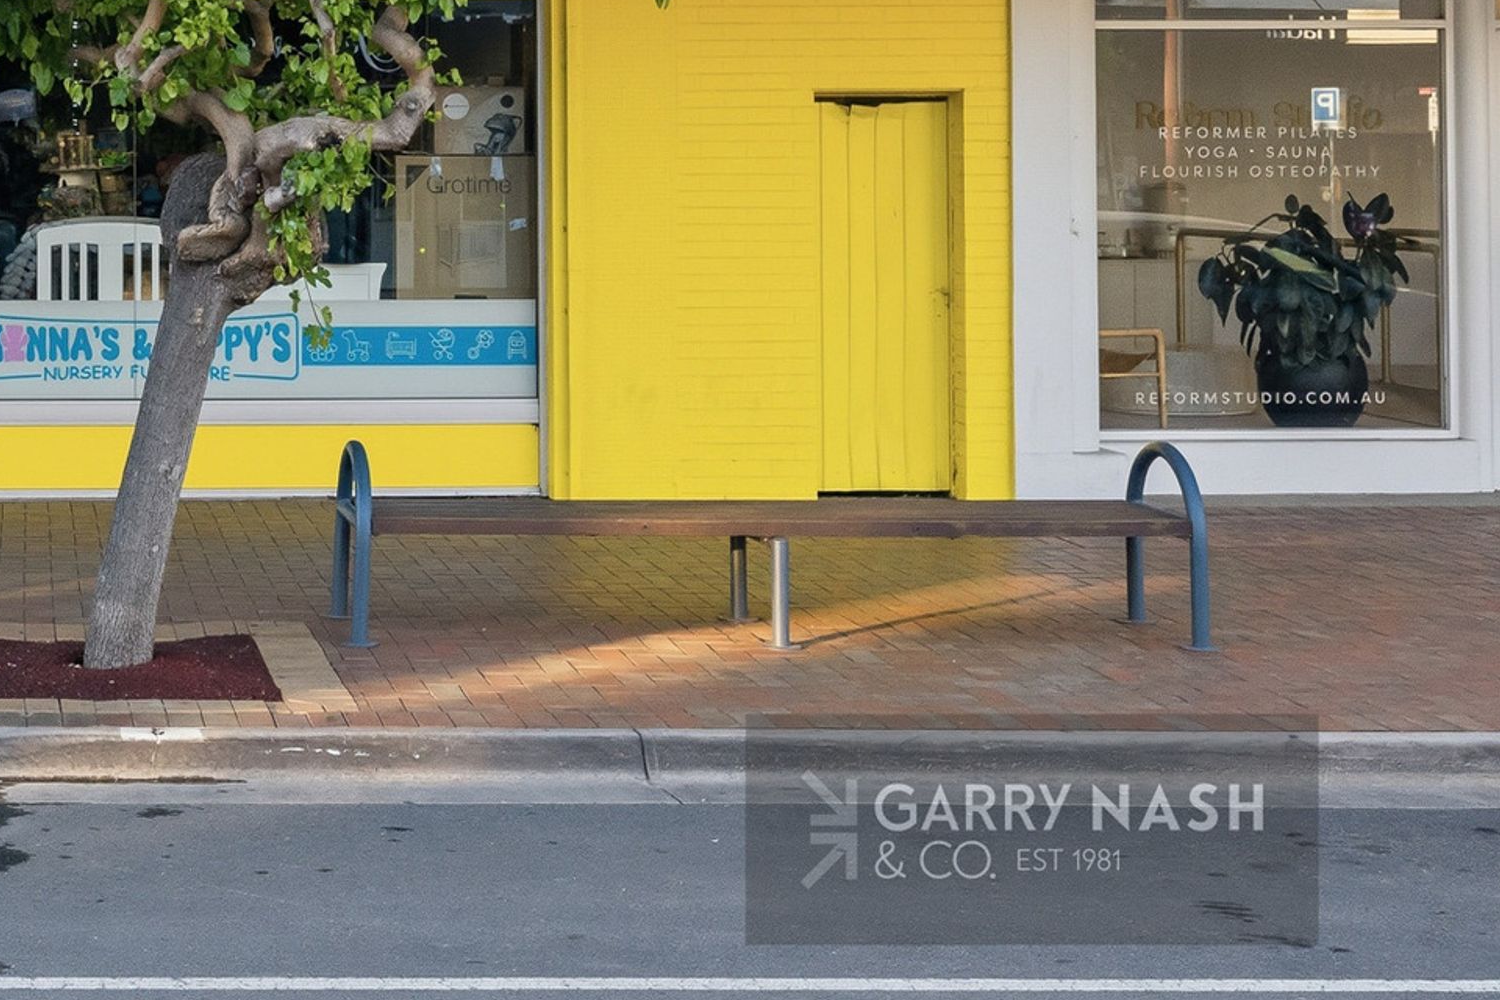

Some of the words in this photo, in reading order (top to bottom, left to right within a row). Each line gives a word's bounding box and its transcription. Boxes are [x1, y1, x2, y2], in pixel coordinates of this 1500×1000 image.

[1158, 126, 1268, 139] REFORMER
[1278, 126, 1358, 139] PILATES
[1184, 146, 1239, 159] YOGA
[1265, 146, 1332, 159] SAUNA
[1139, 165, 1239, 178] FLOURISH
[1249, 165, 1381, 178] OSTEOPATHY
[426, 175, 512, 194] Grotime
[132, 328, 153, 362] &
[216, 322, 291, 363] PY'S
[43, 366, 123, 382] NURSERY
[1135, 391, 1387, 404] REFORMSTUDIO.COM.AU
